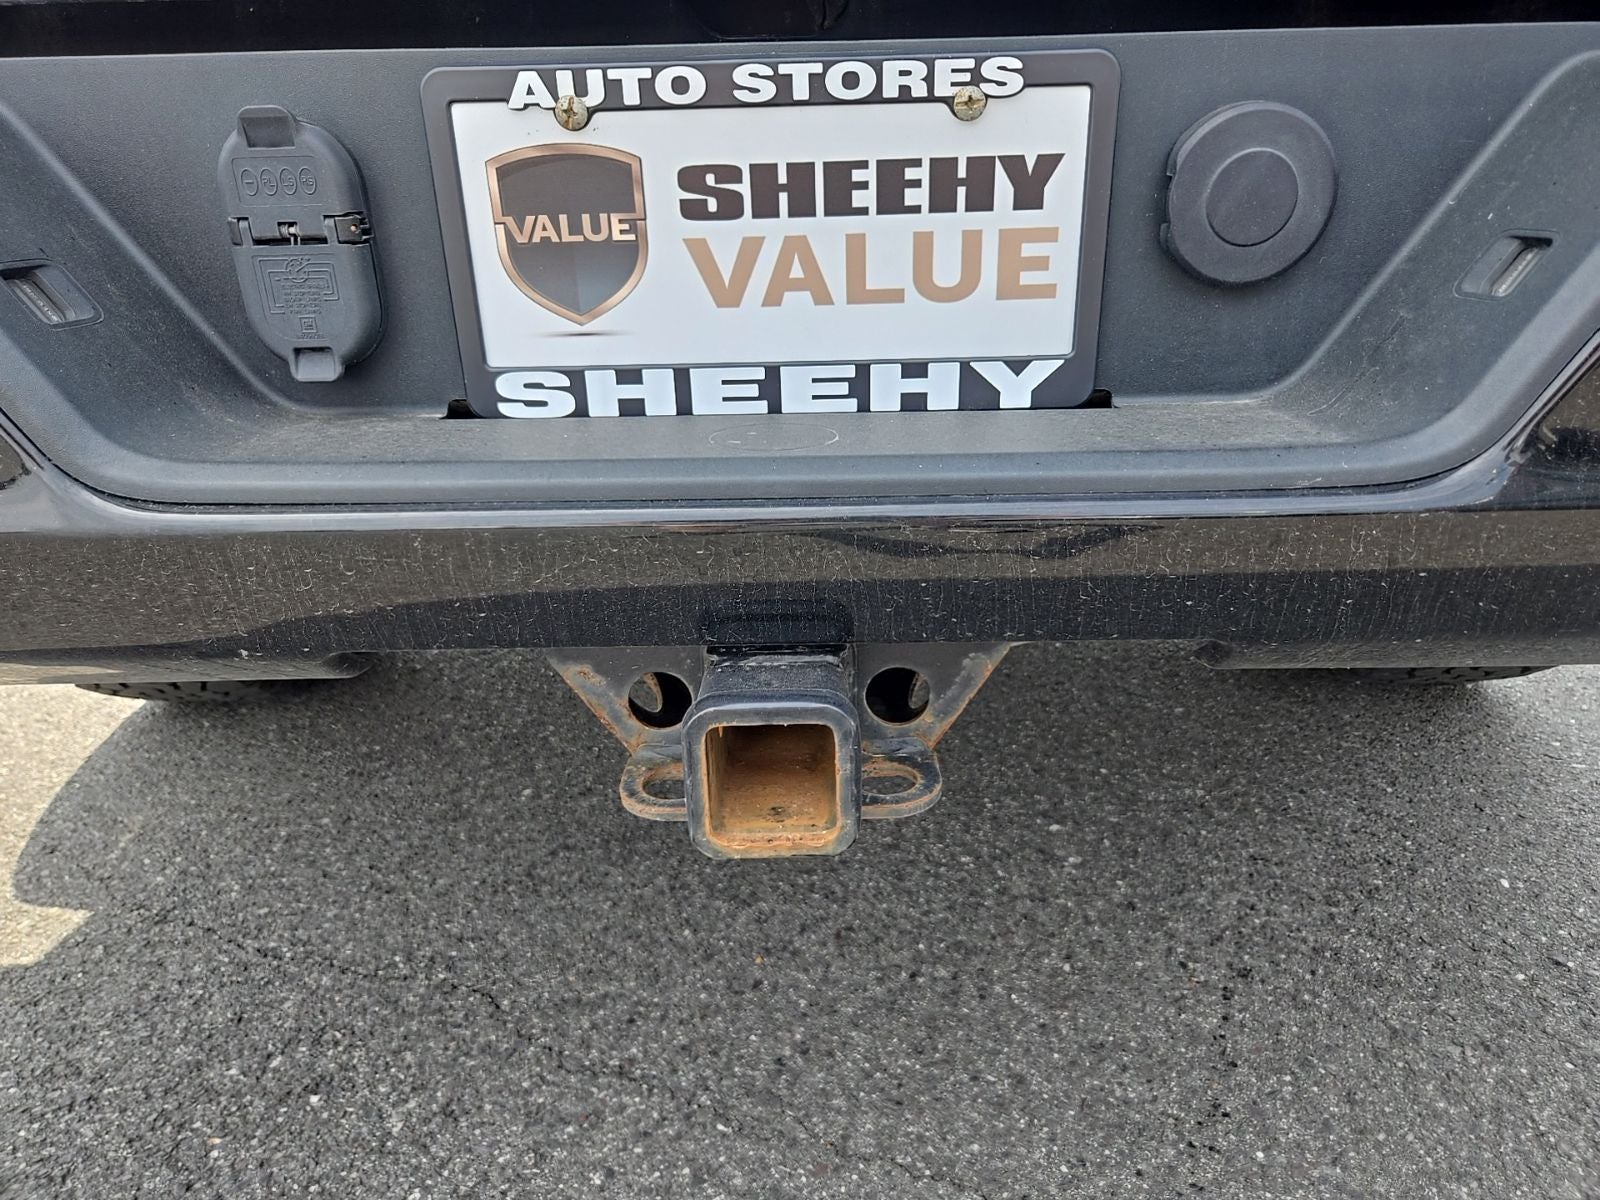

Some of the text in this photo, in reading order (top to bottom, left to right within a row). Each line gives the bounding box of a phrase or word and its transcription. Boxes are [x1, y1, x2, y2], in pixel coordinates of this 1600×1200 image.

[508, 56, 1025, 110] AUTO STORES
[676, 153, 1066, 222] SHEEHY
[505, 211, 637, 245] VALUE
[682, 227, 1060, 308] VALUE
[494, 359, 1065, 419] SHEEHY
